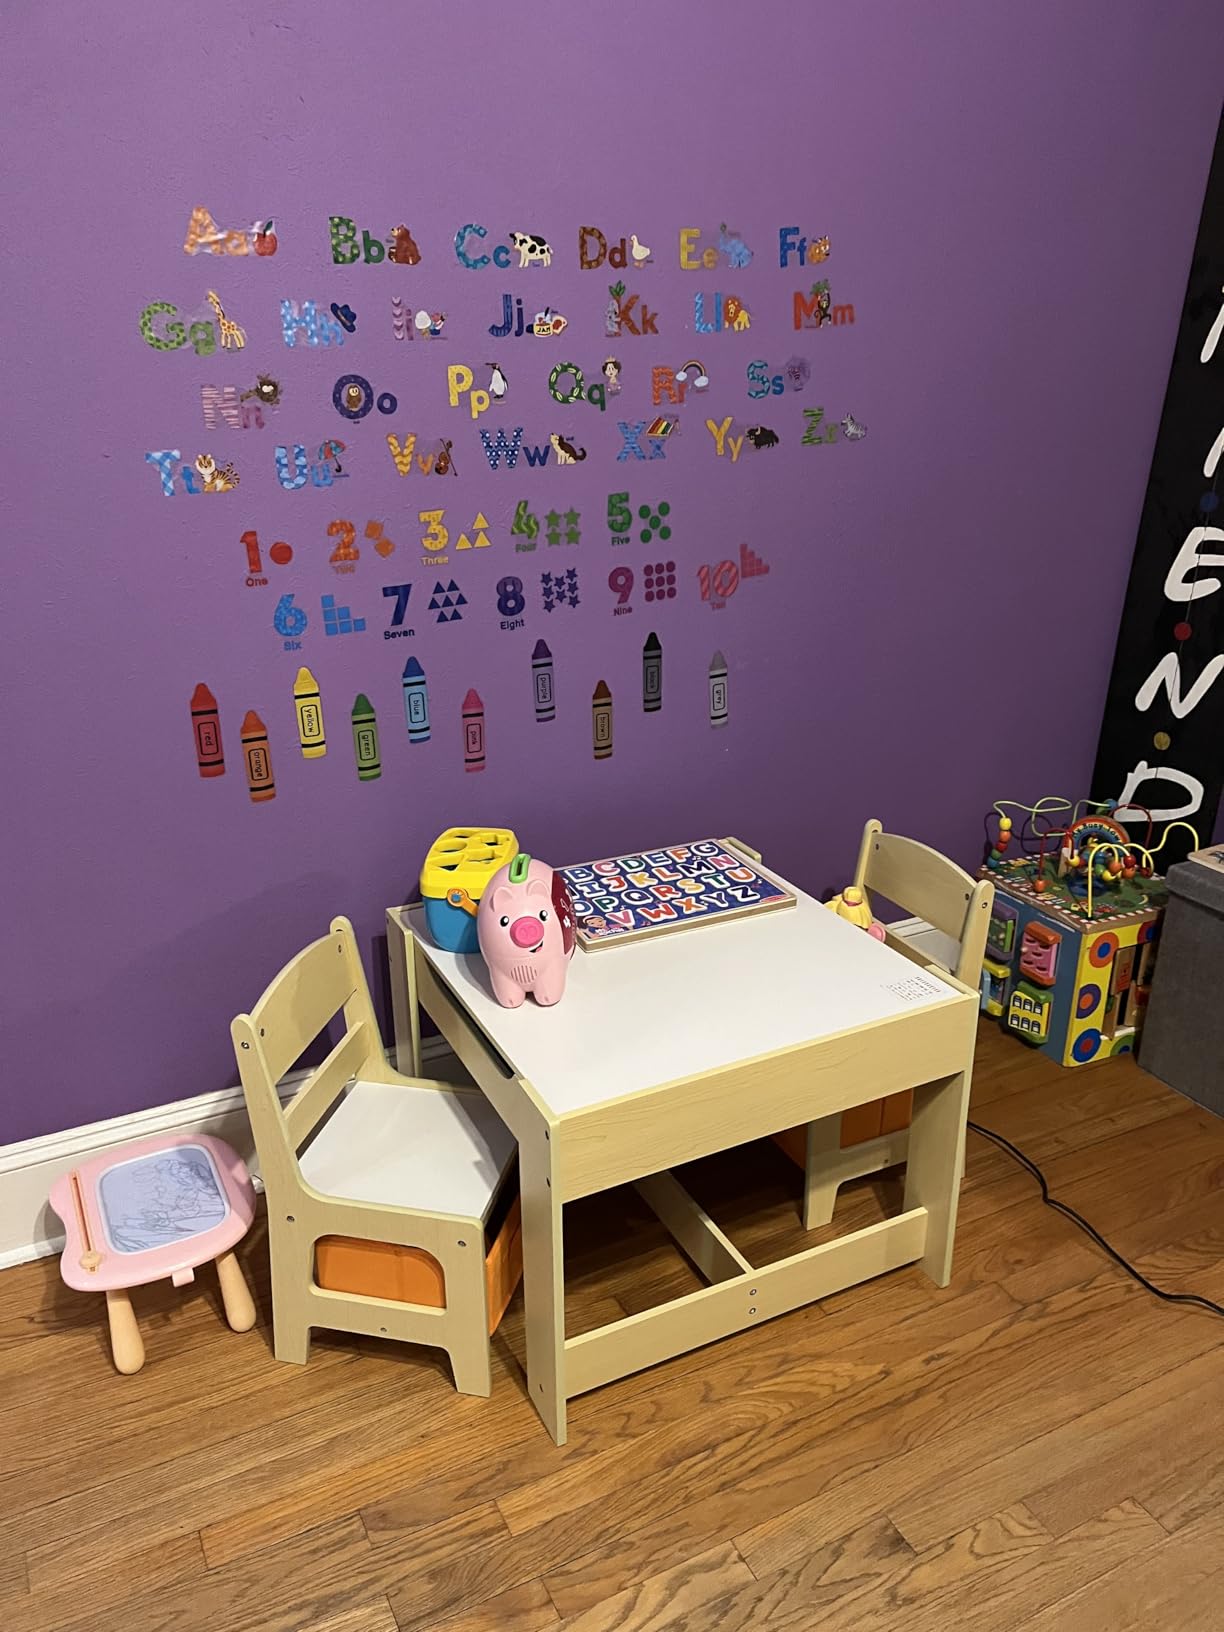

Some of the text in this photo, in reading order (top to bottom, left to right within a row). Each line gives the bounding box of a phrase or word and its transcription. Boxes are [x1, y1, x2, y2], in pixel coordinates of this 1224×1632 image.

[328, 216, 385, 265] Bb
[454, 223, 511, 269] Cc
[579, 226, 627, 270] Dd
[679, 228, 718, 270] Ee
[779, 226, 807, 268] Ff
[140, 302, 216, 356] Gg
[280, 299, 344, 347] Hh
[489, 294, 524, 337] Jj
[613, 294, 659, 336] Kk
[793, 291, 855, 330] Mm
[201, 384, 264, 430] Nn
[333, 374, 398, 420] Oo
[448, 364, 490, 420] Pp
[549, 362, 606, 412] Qq
[747, 360, 785, 399] Ss
[145, 406, 838, 496] Tt Uu Vv Ww Xx Yy Zz
[240, 492, 633, 573] 1 2 3 4 5
[246, 577, 268, 587] One
[611, 536, 630, 546] Five
[273, 559, 739, 637] 6 7 8 9 10
[384, 628, 415, 640] Seven
[500, 618, 525, 631] Eight
[613, 606, 633, 616] Nine
[304, 708, 315, 734] yellow
[413, 699, 421, 716] blue
[204, 731, 214, 746] red
[253, 751, 263, 777] orange
[361, 734, 371, 756] green
